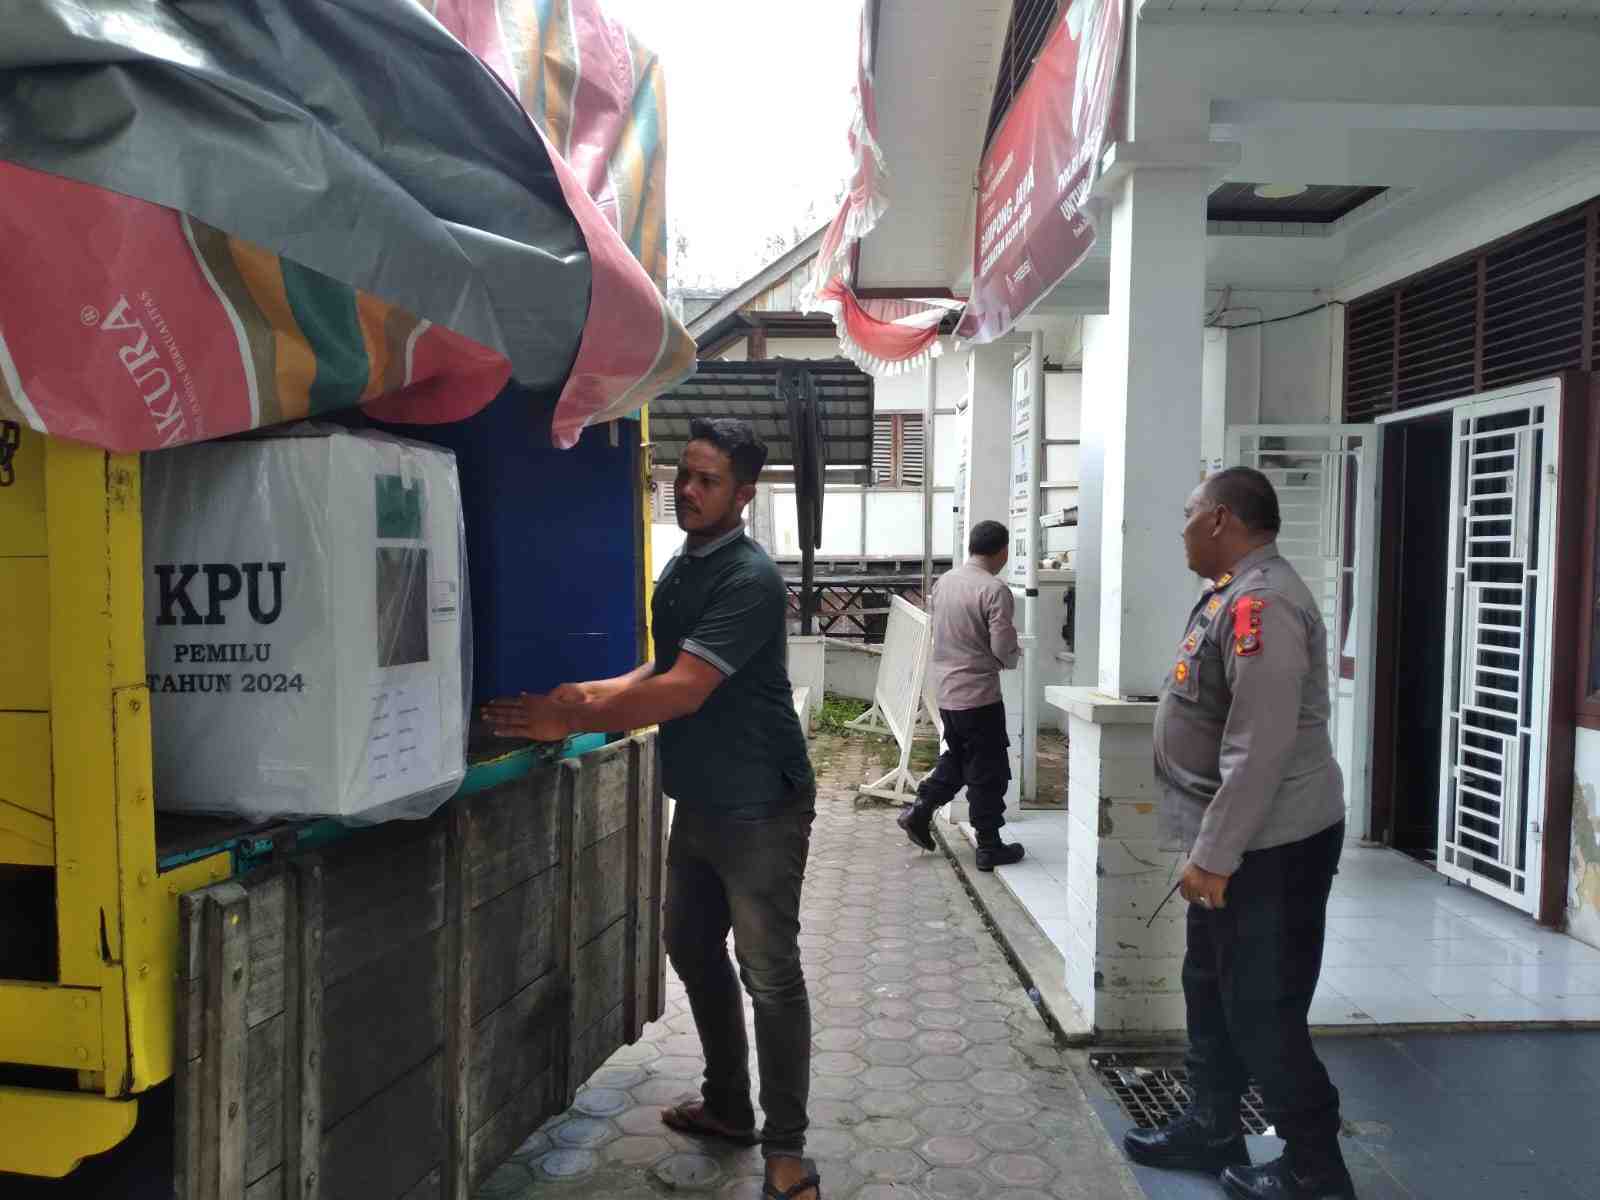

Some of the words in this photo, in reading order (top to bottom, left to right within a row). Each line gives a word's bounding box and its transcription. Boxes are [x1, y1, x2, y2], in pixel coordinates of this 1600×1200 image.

[154, 562, 286, 626] KPU
[173, 643, 271, 663] PEMILU
[145, 673, 232, 694] TAHUN
[241, 672, 305, 694] 2024
